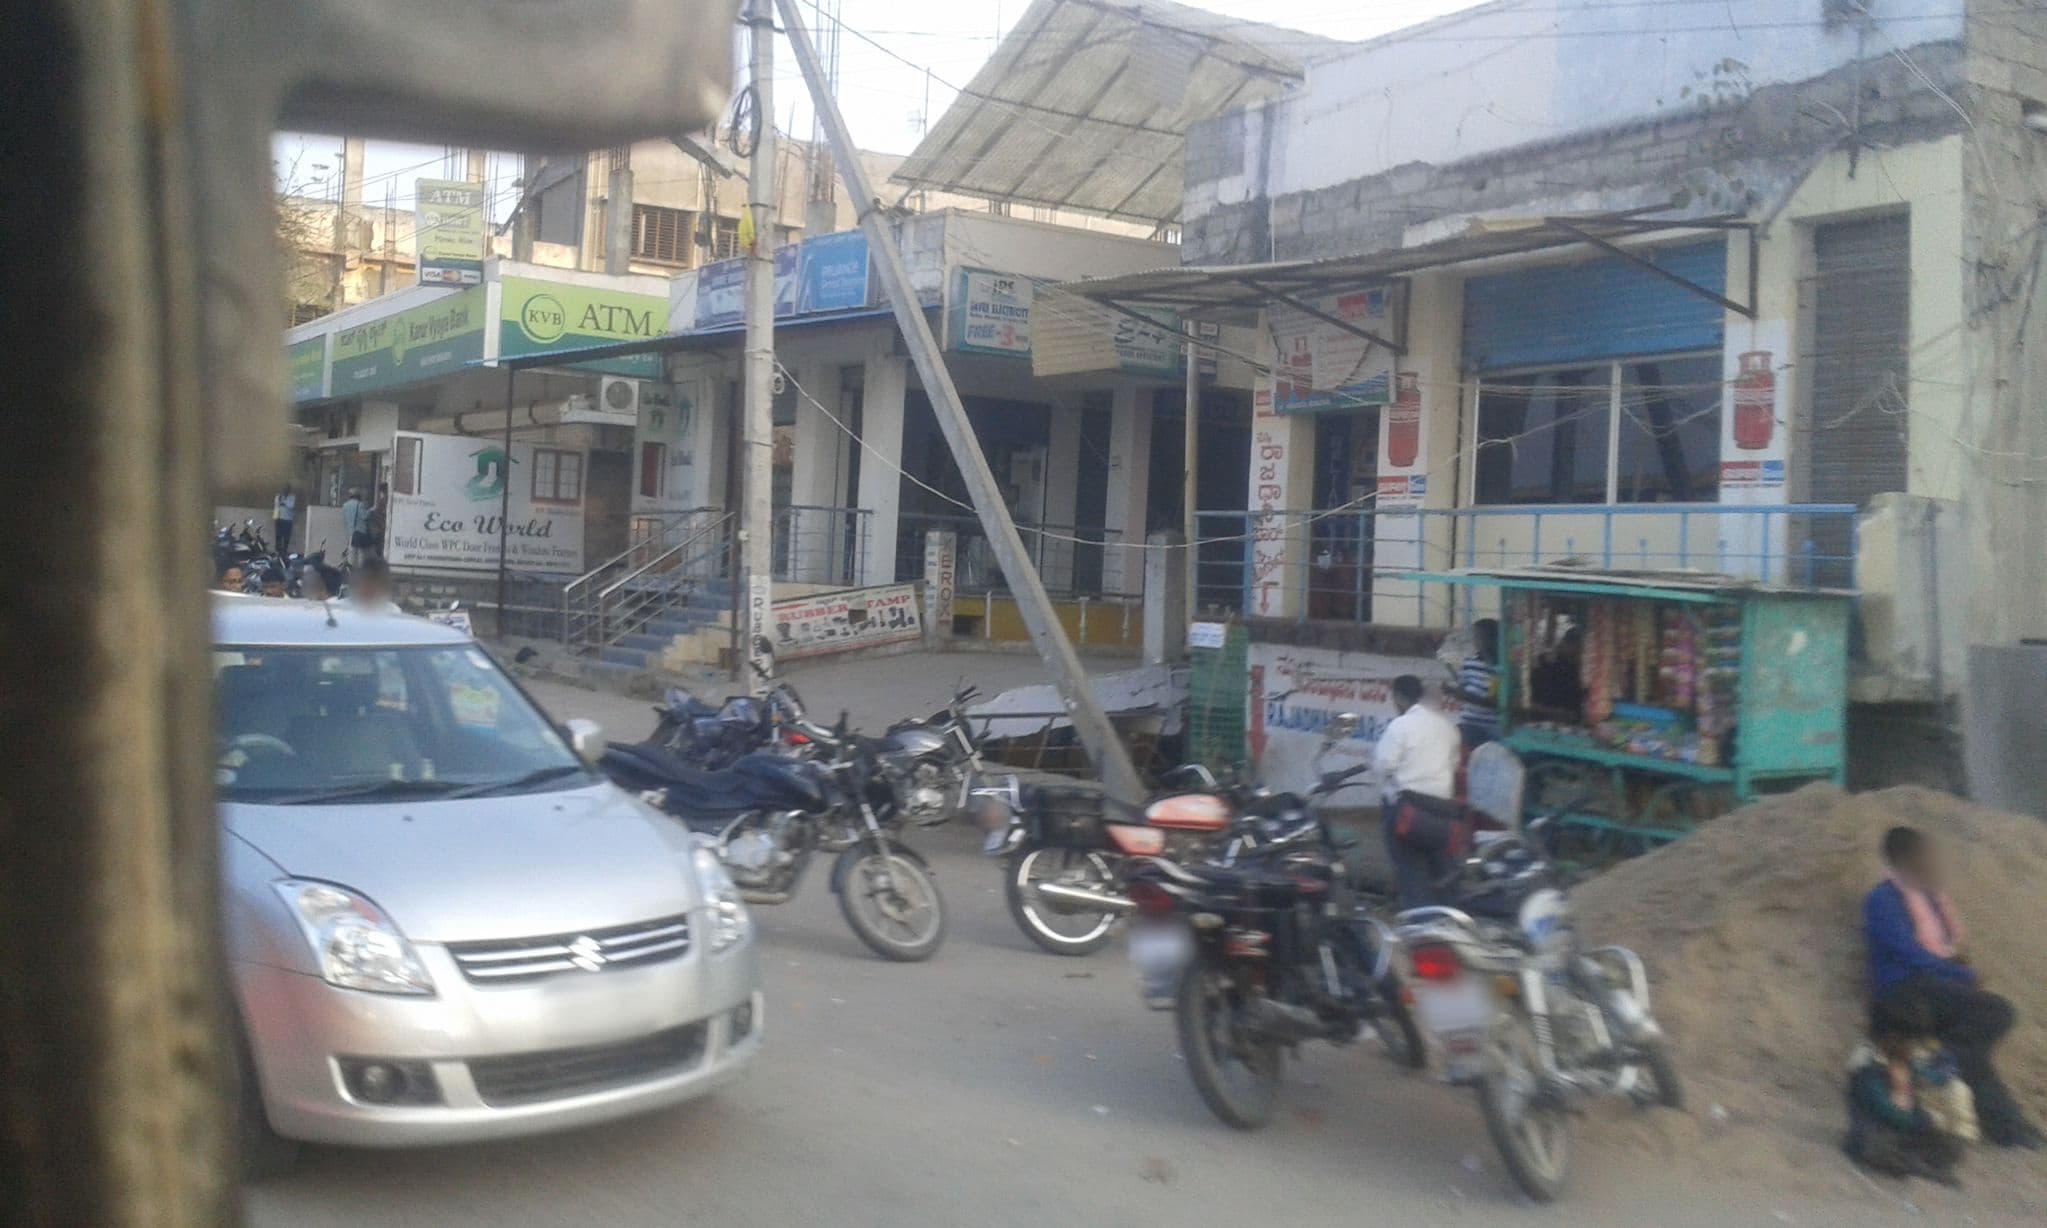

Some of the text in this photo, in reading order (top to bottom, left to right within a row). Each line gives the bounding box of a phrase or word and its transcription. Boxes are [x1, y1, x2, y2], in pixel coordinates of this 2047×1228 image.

[430, 189, 472, 205] ATM
[528, 308, 562, 326] KVB
[578, 303, 654, 337] ATM
[967, 324, 995, 340] FREE
[424, 512, 553, 538] Eco World
[394, 535, 418, 550] World
[441, 538, 460, 550] WPC
[939, 536, 954, 617] XEROX
[777, 604, 849, 621] RUBBER
[864, 594, 912, 609] TAMP
